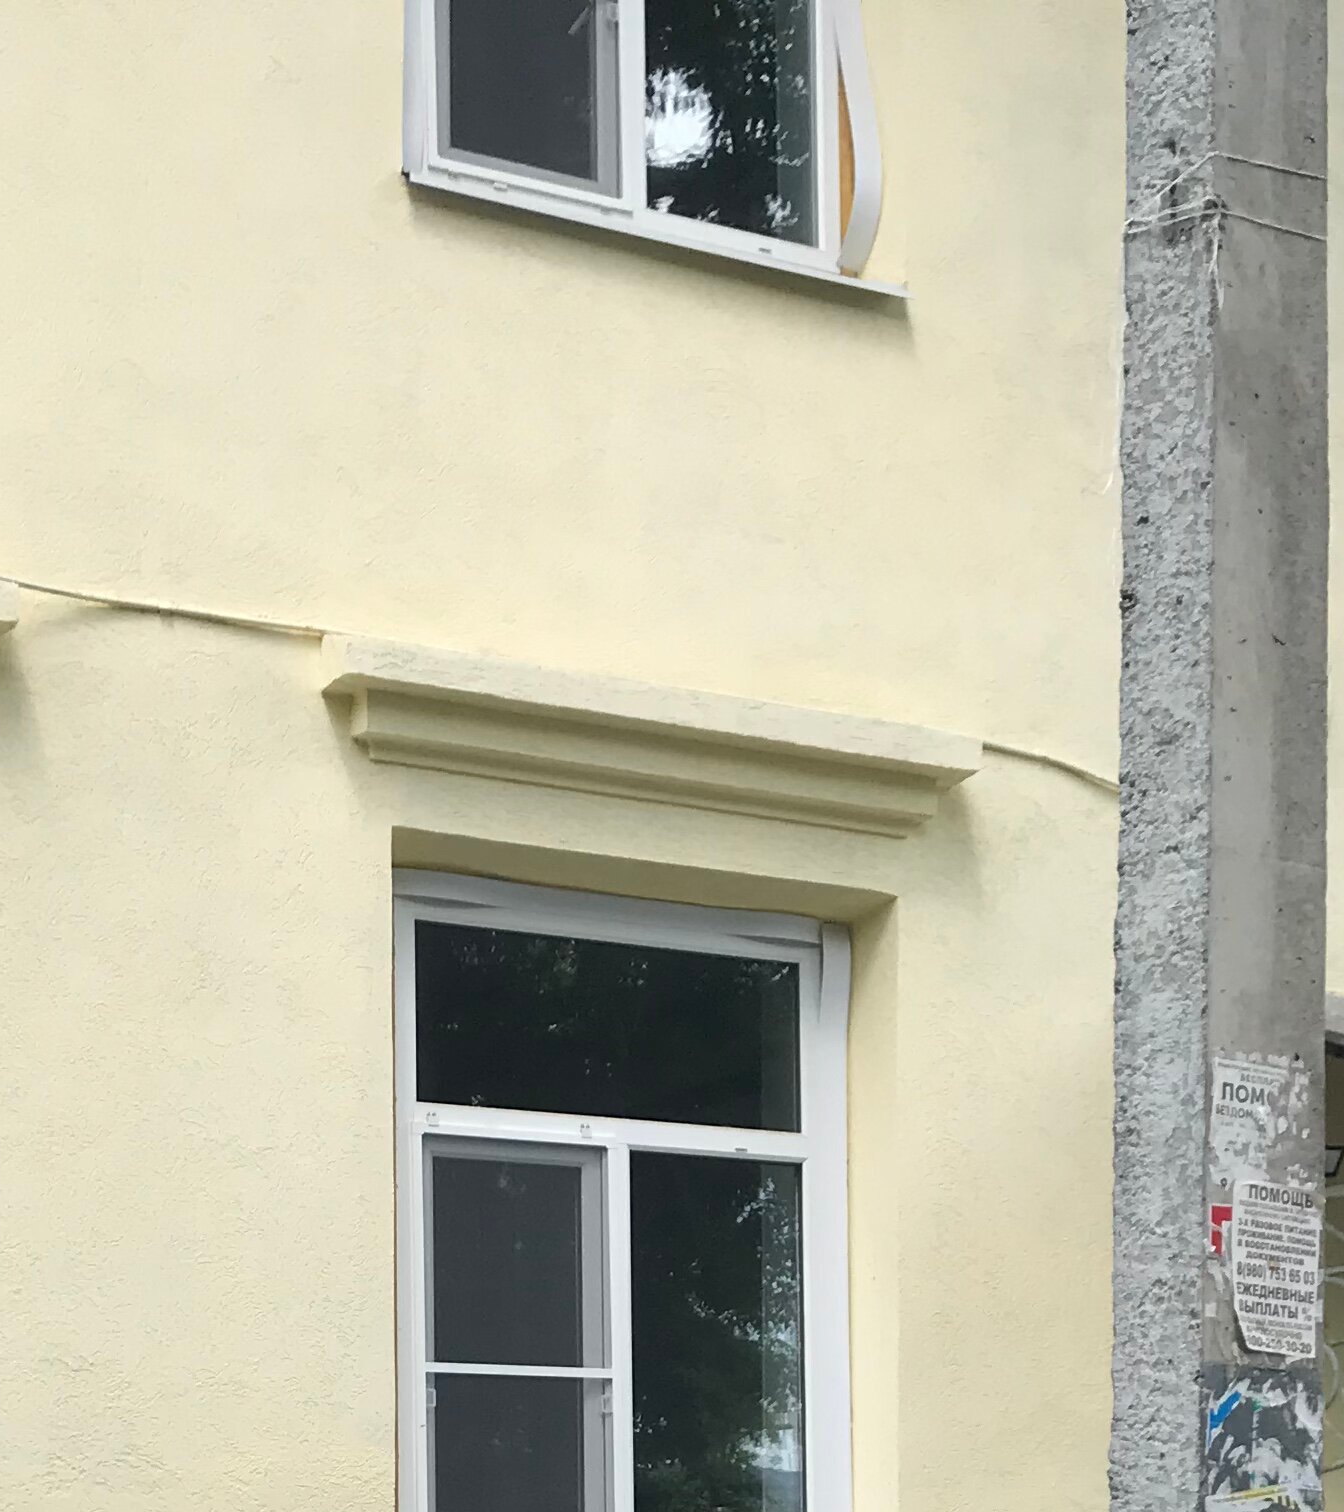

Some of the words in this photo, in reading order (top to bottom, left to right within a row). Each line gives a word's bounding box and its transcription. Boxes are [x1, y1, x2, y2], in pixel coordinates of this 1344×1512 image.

[1248, 1184, 1314, 1209] ПОМОЩЬ
[1236, 1281, 1315, 1305] ЕЖЕДНЕВНЫЕ
[1239, 1299, 1299, 1320] ВЫПЛАТЫ
